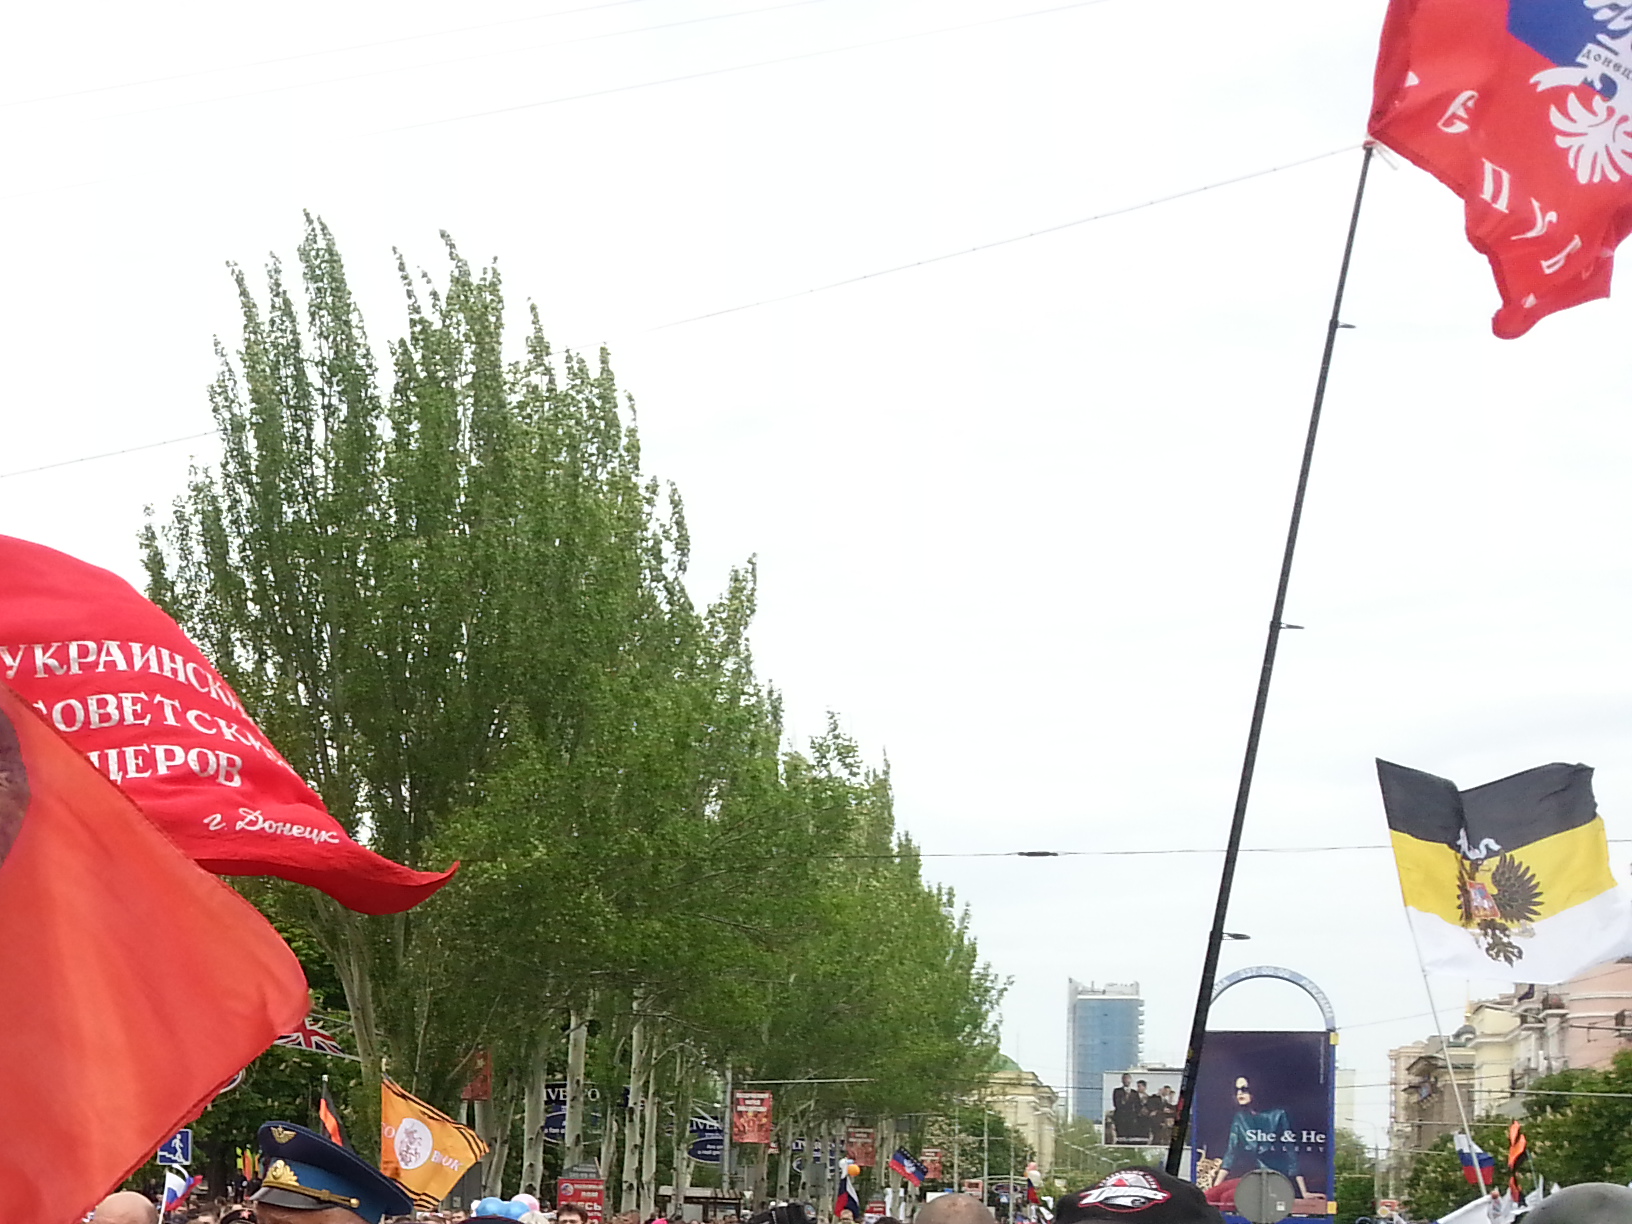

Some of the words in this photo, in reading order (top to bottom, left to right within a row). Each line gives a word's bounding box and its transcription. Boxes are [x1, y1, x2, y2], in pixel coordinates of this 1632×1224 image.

[33, 691, 278, 762] ОВЕТСК
[235, 807, 340, 844] Донецк
[1245, 1129, 1277, 1142] She
[1280, 1130, 1296, 1142] &
[1302, 1130, 1326, 1143] He
